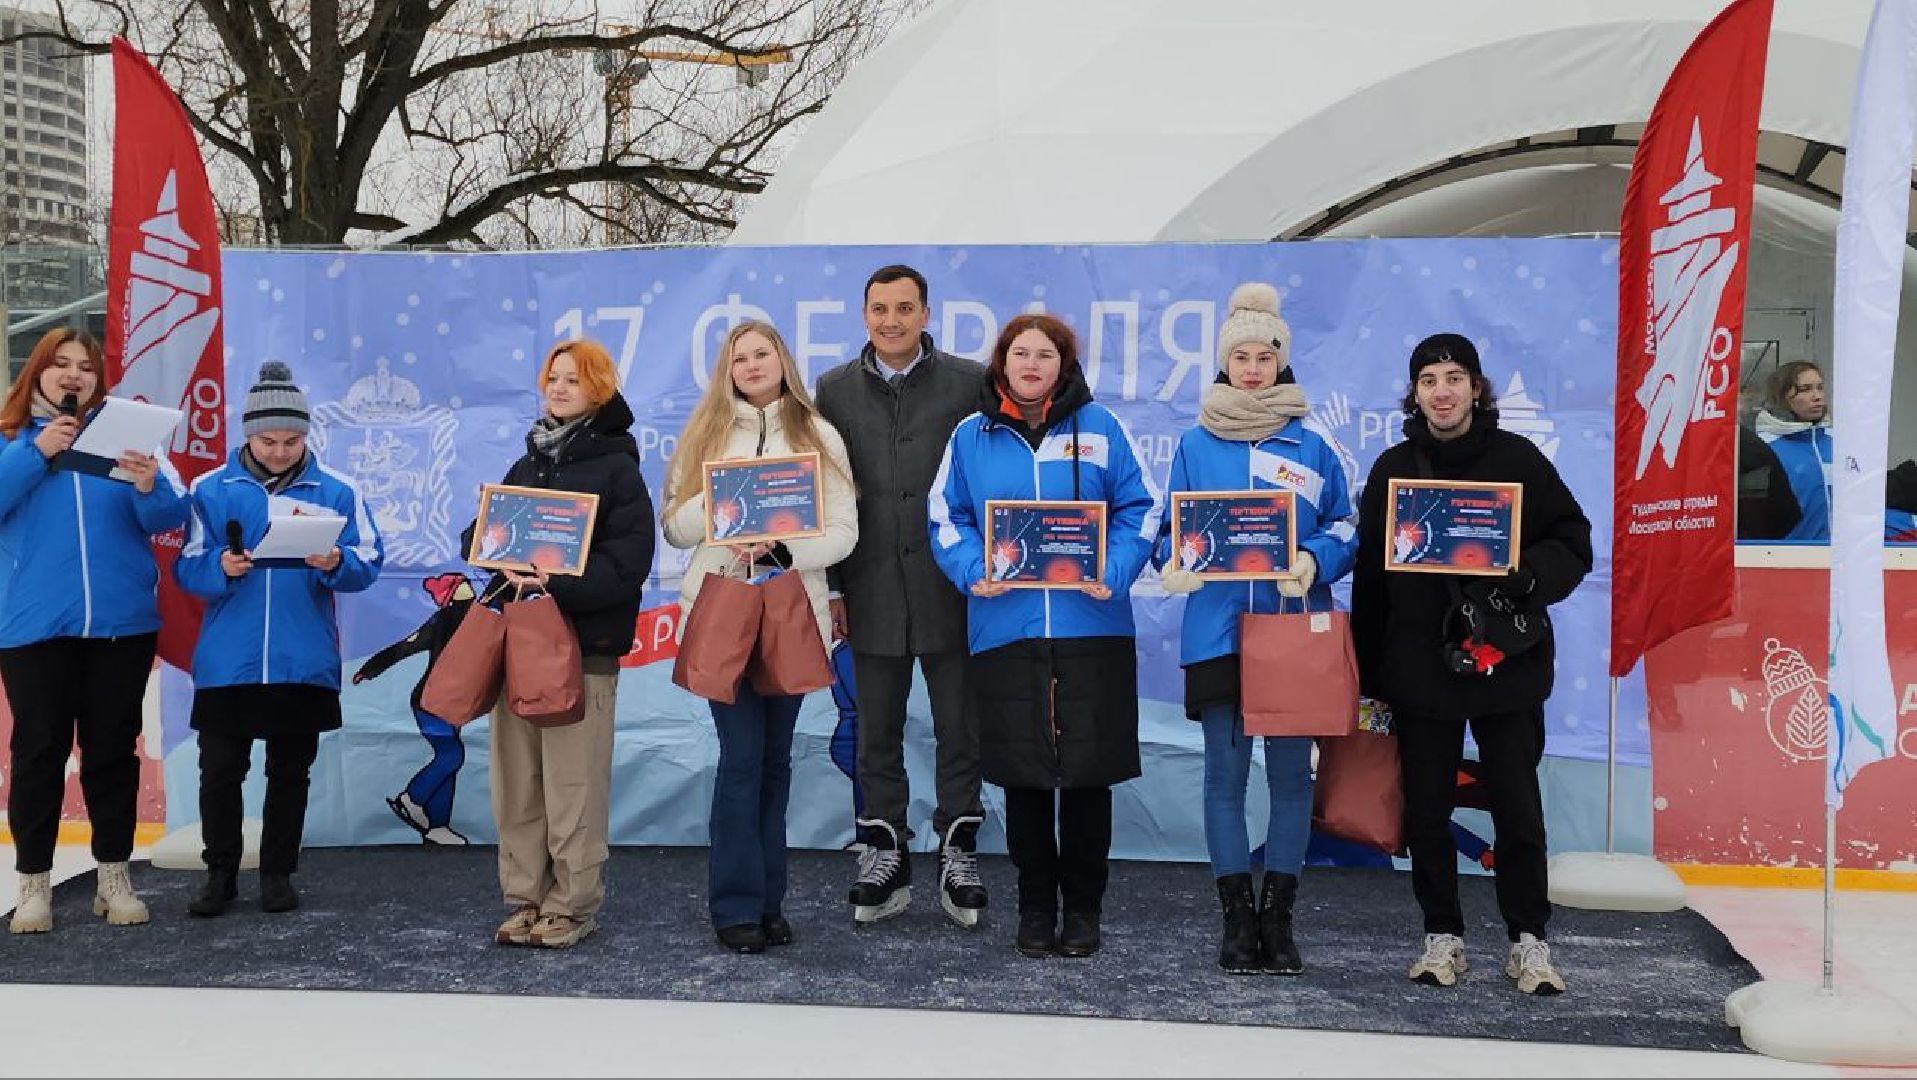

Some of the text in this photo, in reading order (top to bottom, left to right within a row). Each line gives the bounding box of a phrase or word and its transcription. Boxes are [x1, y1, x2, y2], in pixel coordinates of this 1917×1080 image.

[692, 293, 1217, 402] ФЕРЛЯ
[1703, 327, 1733, 419] РСО
[188, 378, 221, 460] РСО
